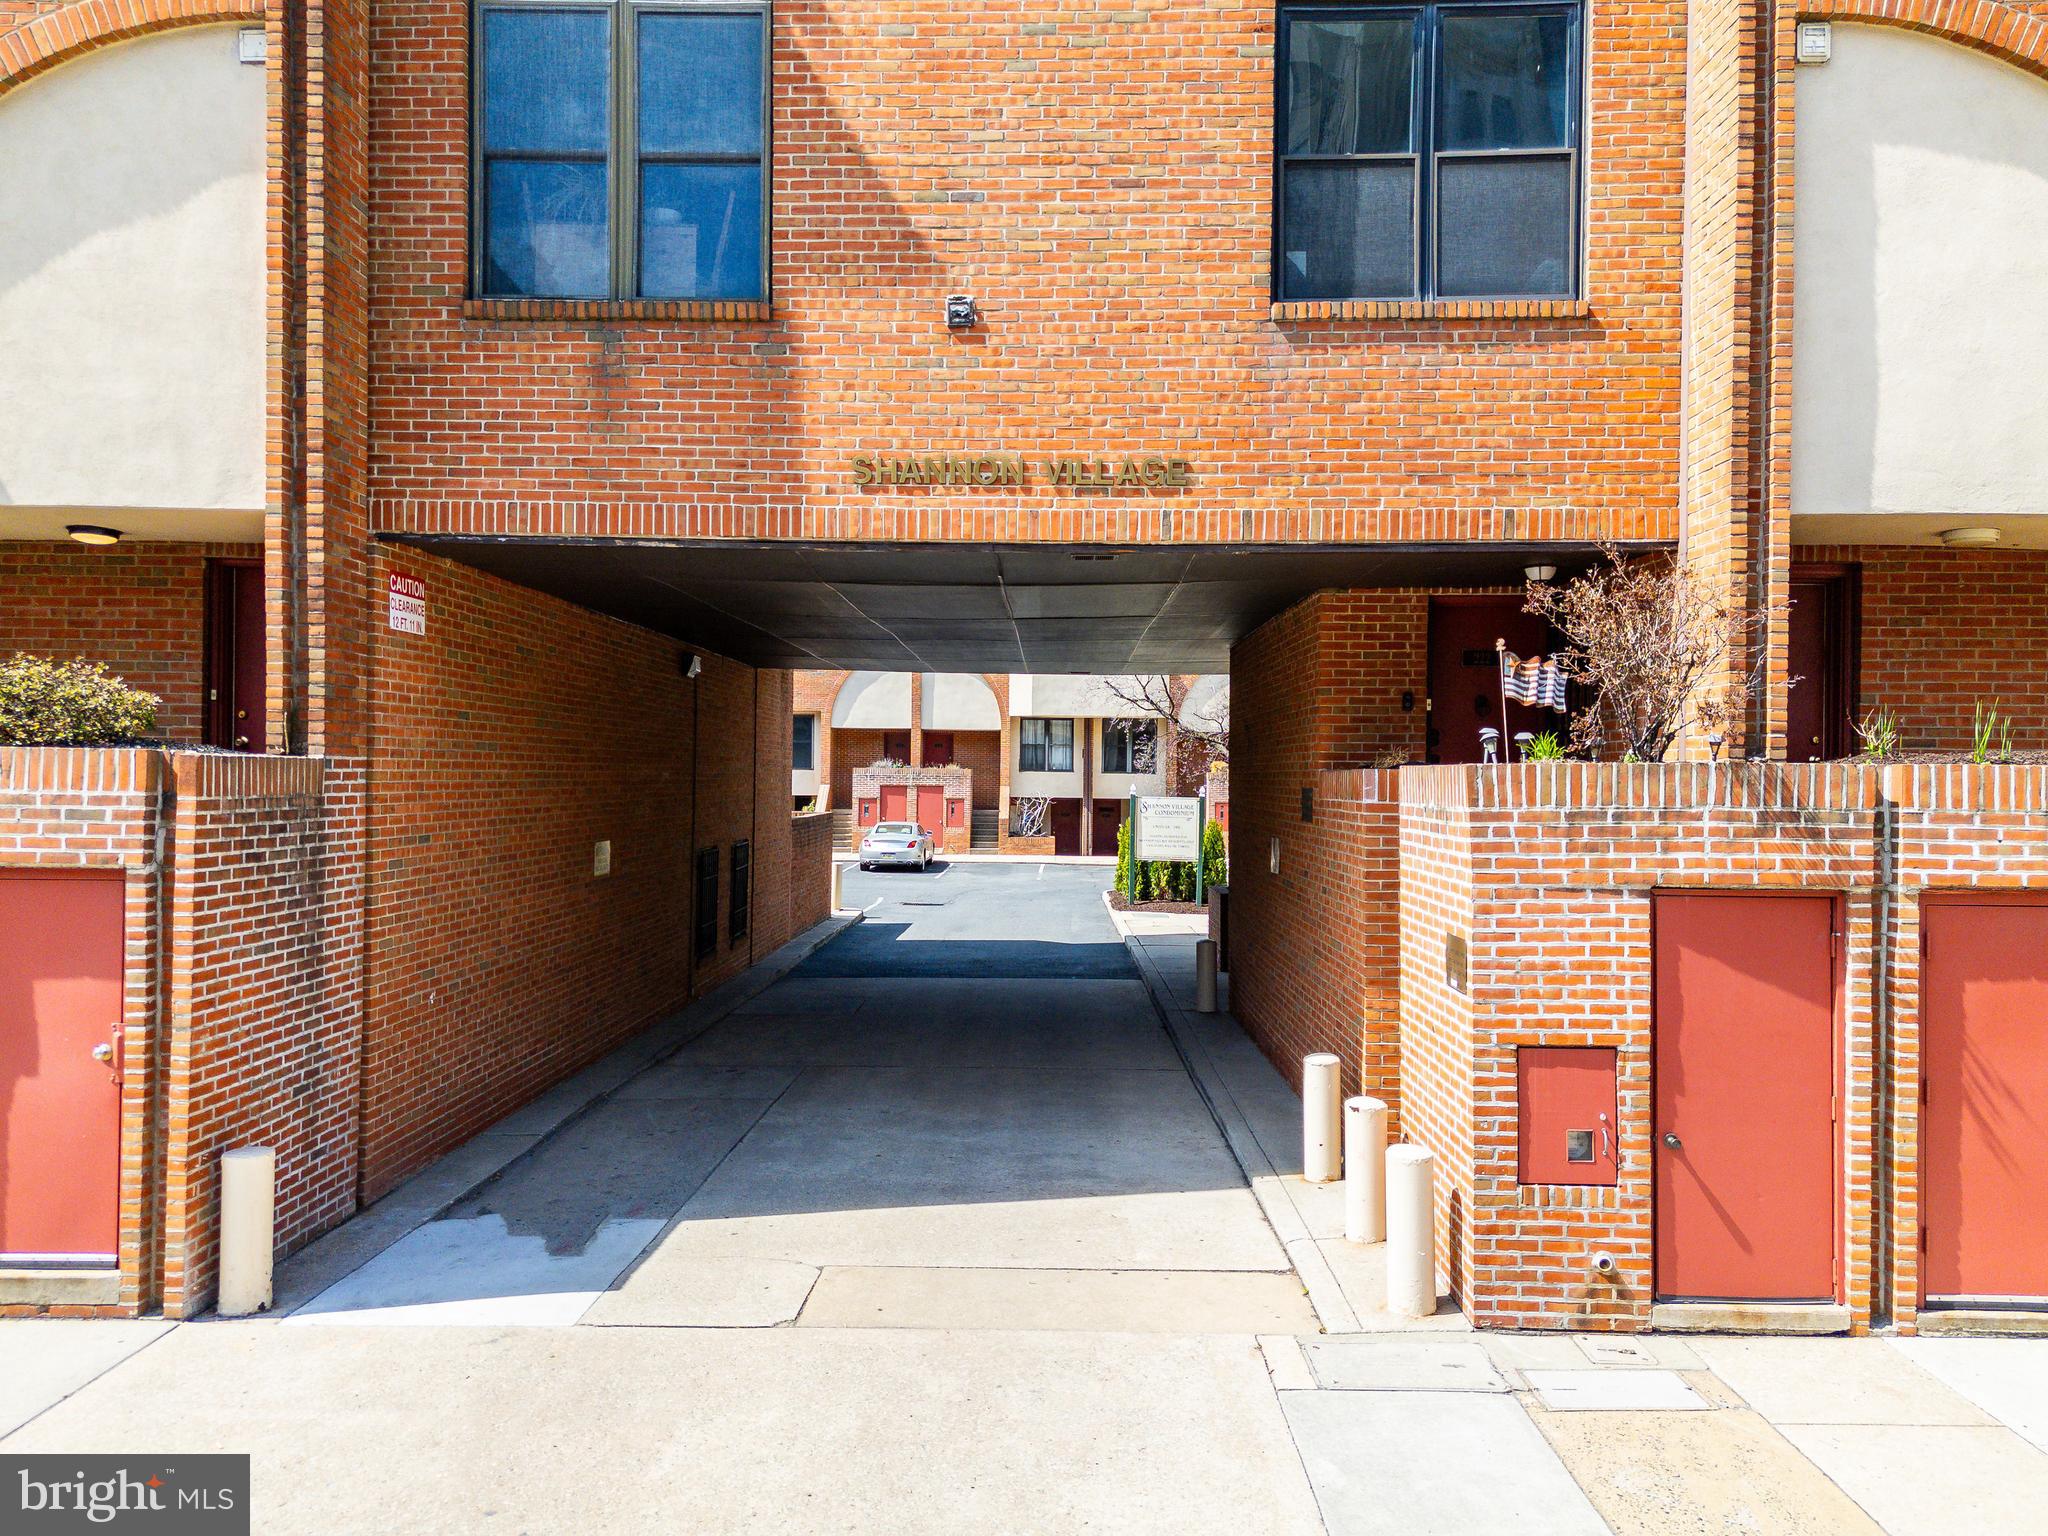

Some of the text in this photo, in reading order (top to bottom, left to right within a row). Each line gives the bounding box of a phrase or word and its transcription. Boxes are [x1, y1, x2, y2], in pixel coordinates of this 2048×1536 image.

[851, 454, 1188, 487] SHANNON VILLAGE
[390, 575, 425, 598] CAUTION
[390, 597, 425, 617] CLEARANCE
[393, 616, 399, 629] 12
[410, 620, 415, 632] 11
[1140, 801, 1170, 814] SHANNON
